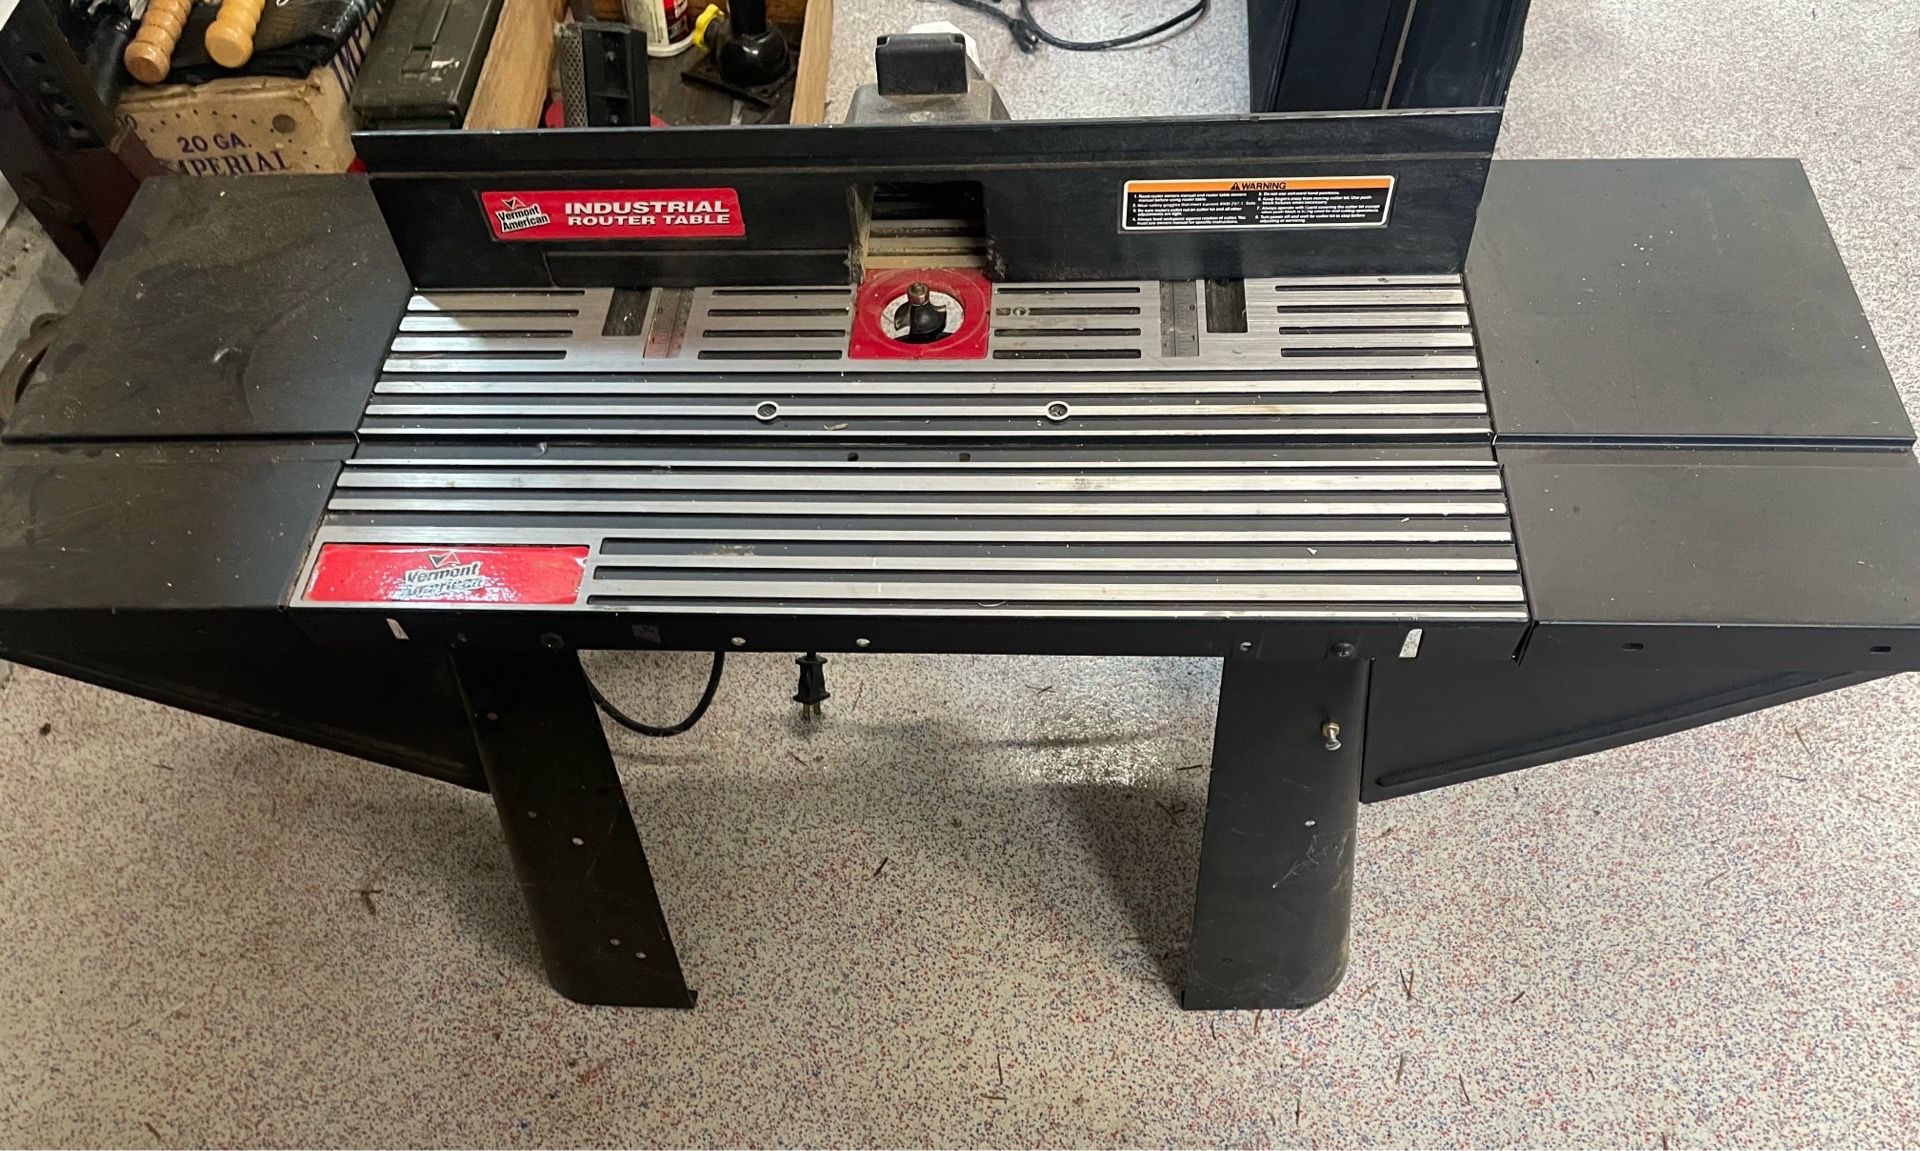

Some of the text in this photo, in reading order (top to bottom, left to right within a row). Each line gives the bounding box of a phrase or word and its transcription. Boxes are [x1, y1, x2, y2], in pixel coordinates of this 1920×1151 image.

[177, 132, 252, 153] 20 GA.
[1241, 182, 1287, 190] WARNING
[498, 205, 539, 221] Vermont
[565, 201, 729, 214] INDUSTRIAL
[503, 215, 548, 231] American
[568, 214, 730, 226] ROUTER TABLE
[408, 563, 479, 582] Vermont
